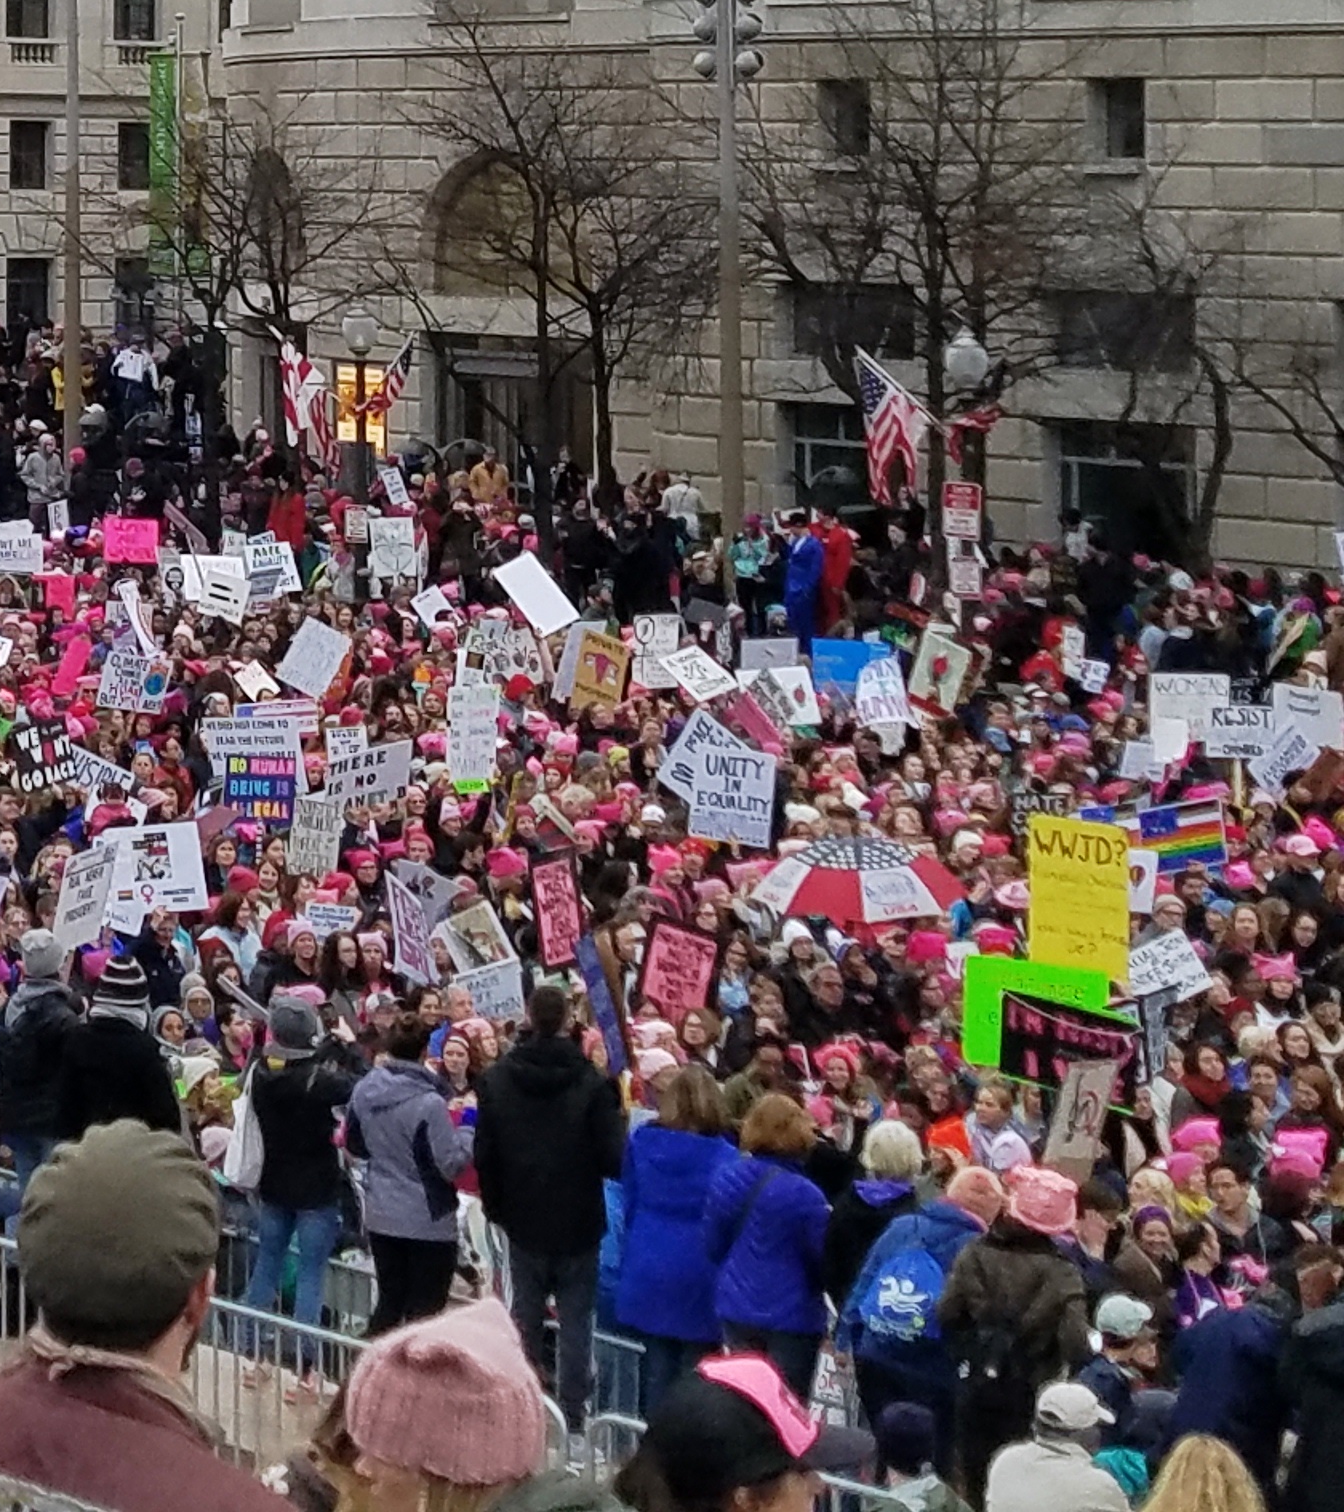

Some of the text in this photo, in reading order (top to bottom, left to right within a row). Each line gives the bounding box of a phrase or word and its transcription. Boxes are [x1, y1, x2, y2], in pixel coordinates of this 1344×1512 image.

[1212, 707, 1272, 729] RESIST
[15, 726, 39, 751] WE
[21, 759, 77, 793] GO BACK
[229, 757, 295, 775] NO HUMAN
[329, 750, 388, 777] THERE
[705, 753, 765, 780] UNITY
[230, 779, 289, 796] BEING IS
[328, 773, 377, 797] IS NO
[724, 777, 742, 793] IN
[696, 790, 770, 815] EQUALITY
[1034, 829, 1128, 867] WWJD?
